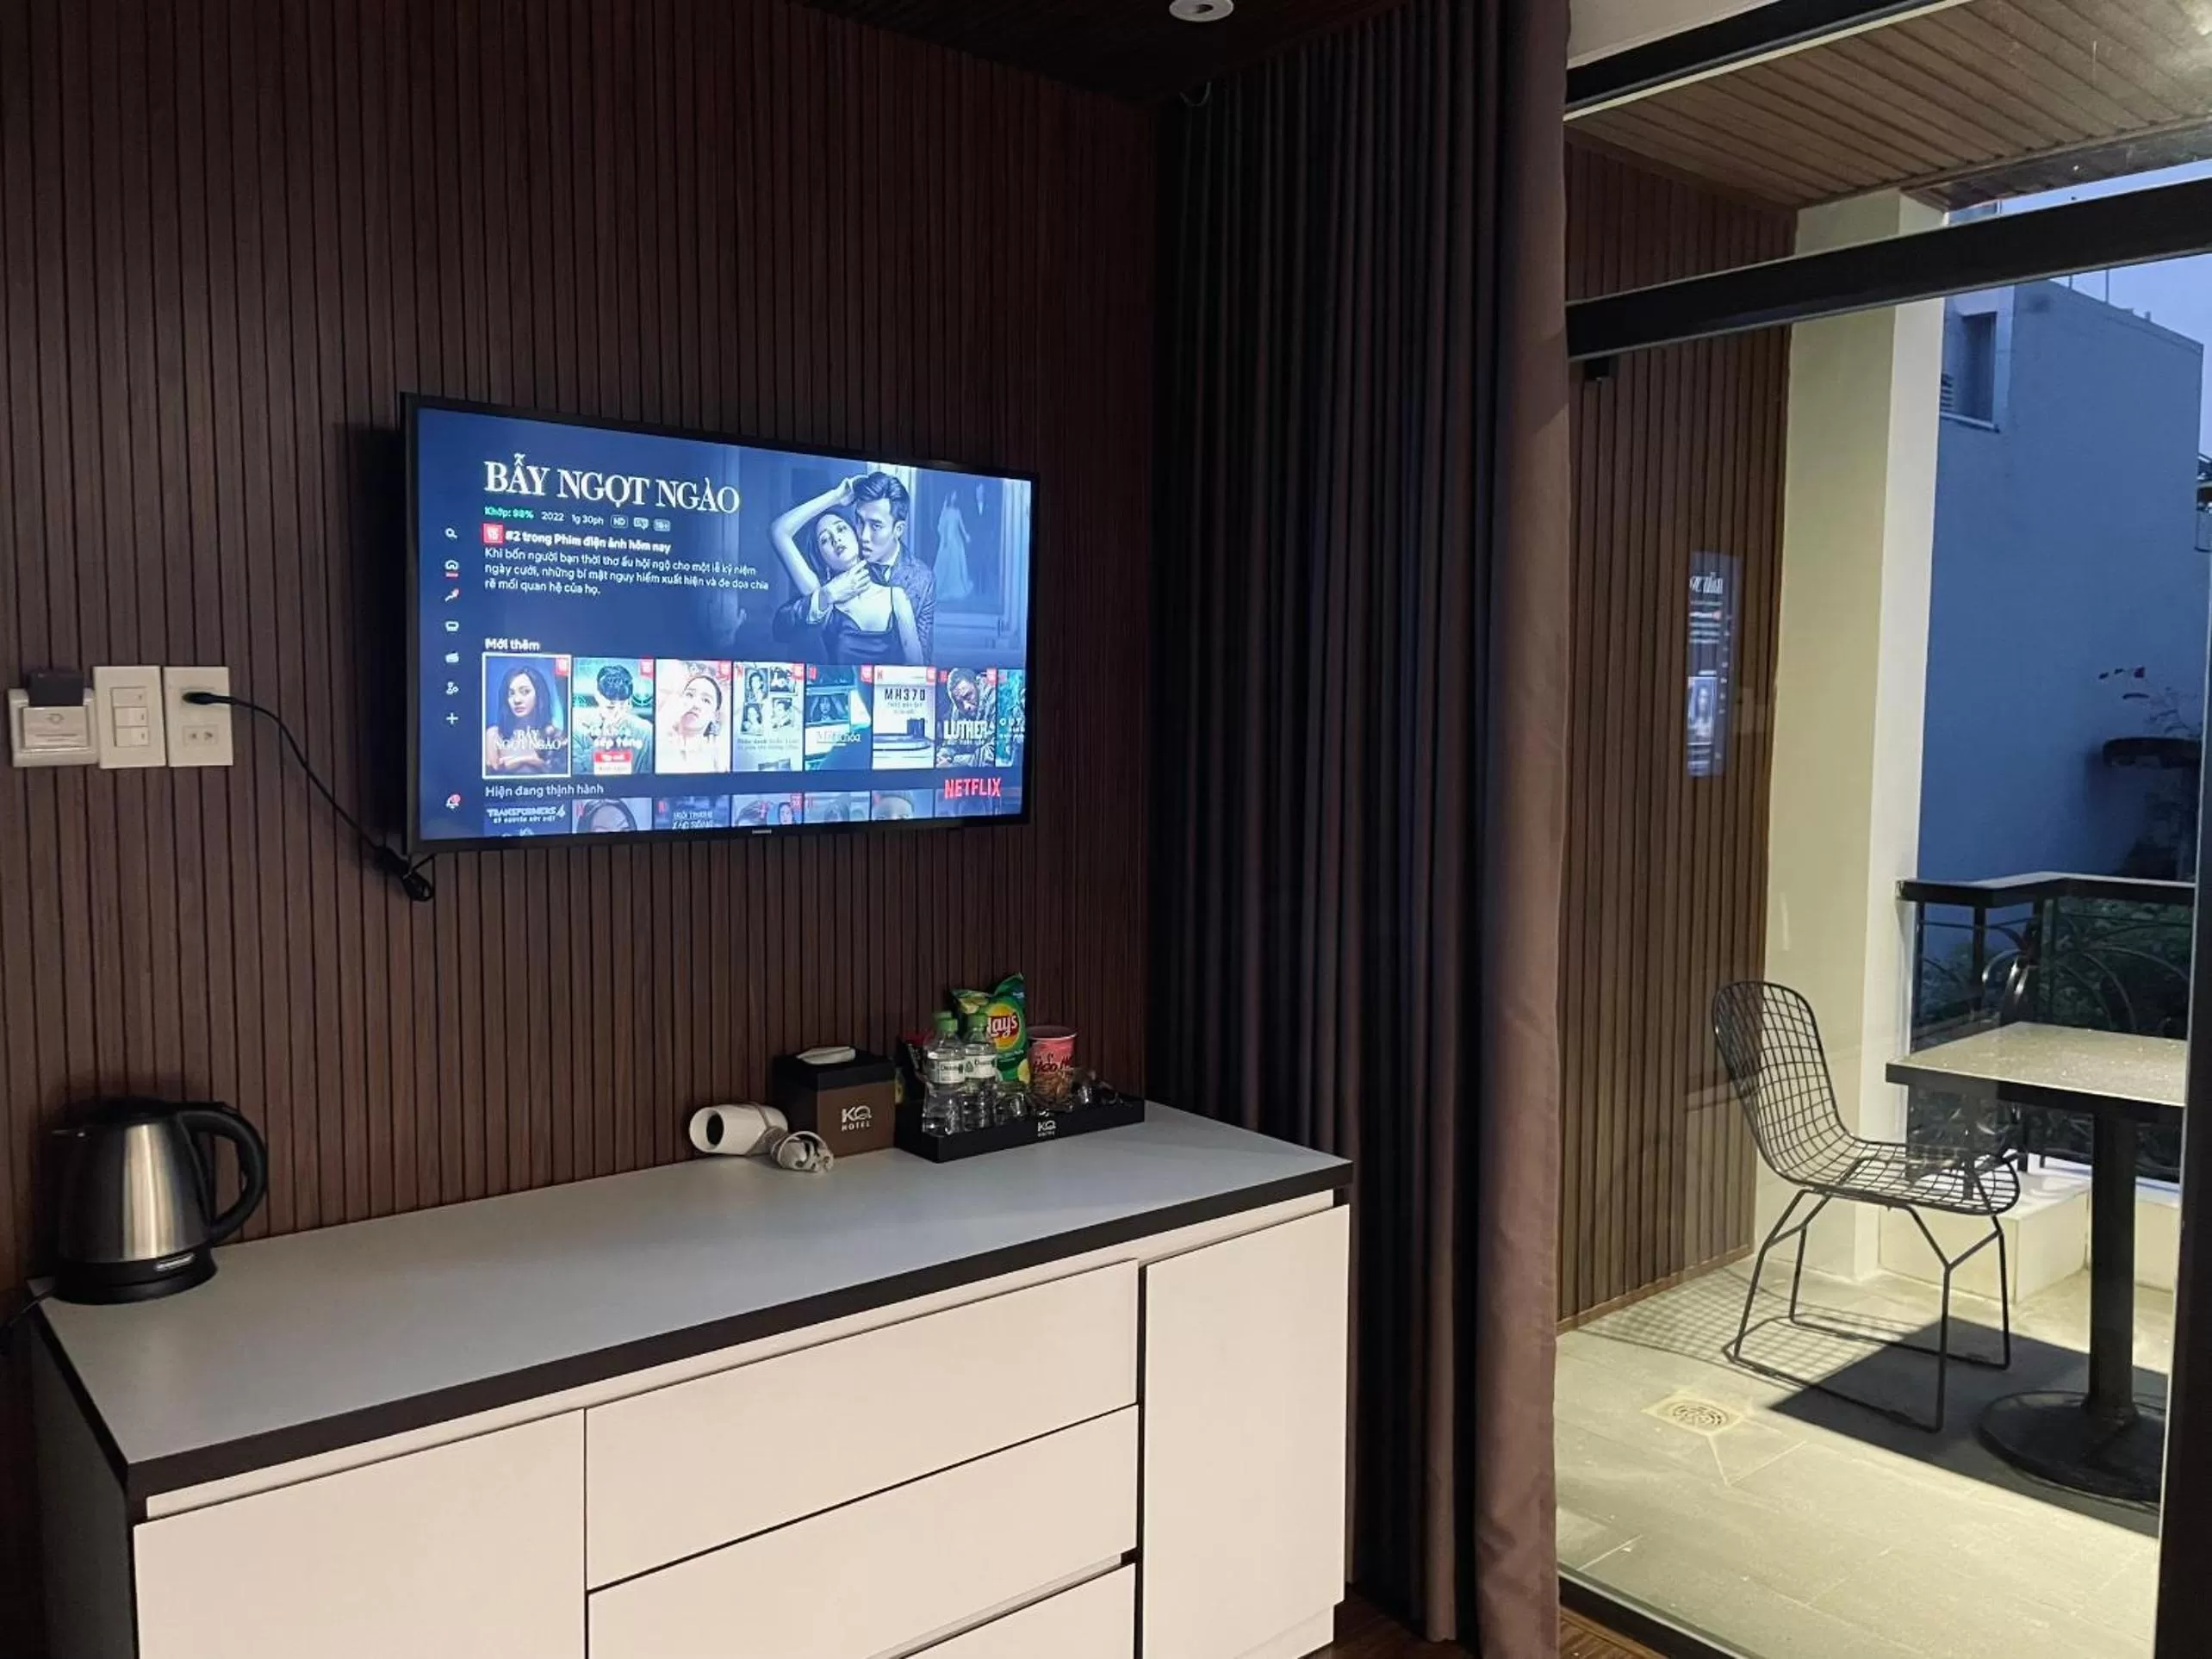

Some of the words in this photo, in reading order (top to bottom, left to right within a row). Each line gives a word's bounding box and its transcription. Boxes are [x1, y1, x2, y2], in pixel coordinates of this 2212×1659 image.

[484, 453, 550, 496] BẪY
[557, 469, 649, 507] NGỌT
[656, 478, 740, 513] NGÀO
[541, 512, 564, 521] 2022
[522, 532, 552, 546] trong
[555, 533, 581, 545] Phim
[583, 535, 606, 550] điện
[629, 538, 651, 551] hôm
[652, 542, 671, 555] nay
[485, 548, 502, 558] Khi
[505, 547, 525, 560] bốn
[528, 550, 557, 562] người
[560, 552, 579, 565] bạn
[581, 553, 601, 565] thời
[603, 556, 619, 566] thơ
[636, 557, 651, 569] hội
[652, 560, 671, 571] ngộ
[673, 561, 690, 570] cho
[692, 562, 711, 575] một
[734, 565, 756, 576] niệm
[485, 564, 512, 576] ngày
[542, 567, 575, 580] những
[577, 569, 587, 579] bí
[588, 569, 608, 581] mật
[610, 574, 634, 584] nguy
[637, 571, 660, 583] hiểm
[662, 574, 683, 585] xuất
[684, 575, 705, 587] hiện
[706, 576, 717, 586] và
[750, 580, 769, 590] chia
[498, 578, 518, 589] mối
[520, 582, 547, 593] quan
[550, 581, 562, 593] hệ
[564, 582, 583, 593] của
[585, 584, 601, 595] họ.
[485, 637, 510, 650] Mới
[511, 639, 540, 651] thêm
[885, 687, 926, 701] MH370
[485, 785, 513, 798] Hiện
[515, 785, 544, 798] đang
[546, 784, 575, 797] thịnh
[576, 783, 605, 795] hành
[944, 778, 1002, 799] NETFLIX
[842, 1121, 870, 1132] HOTEL
